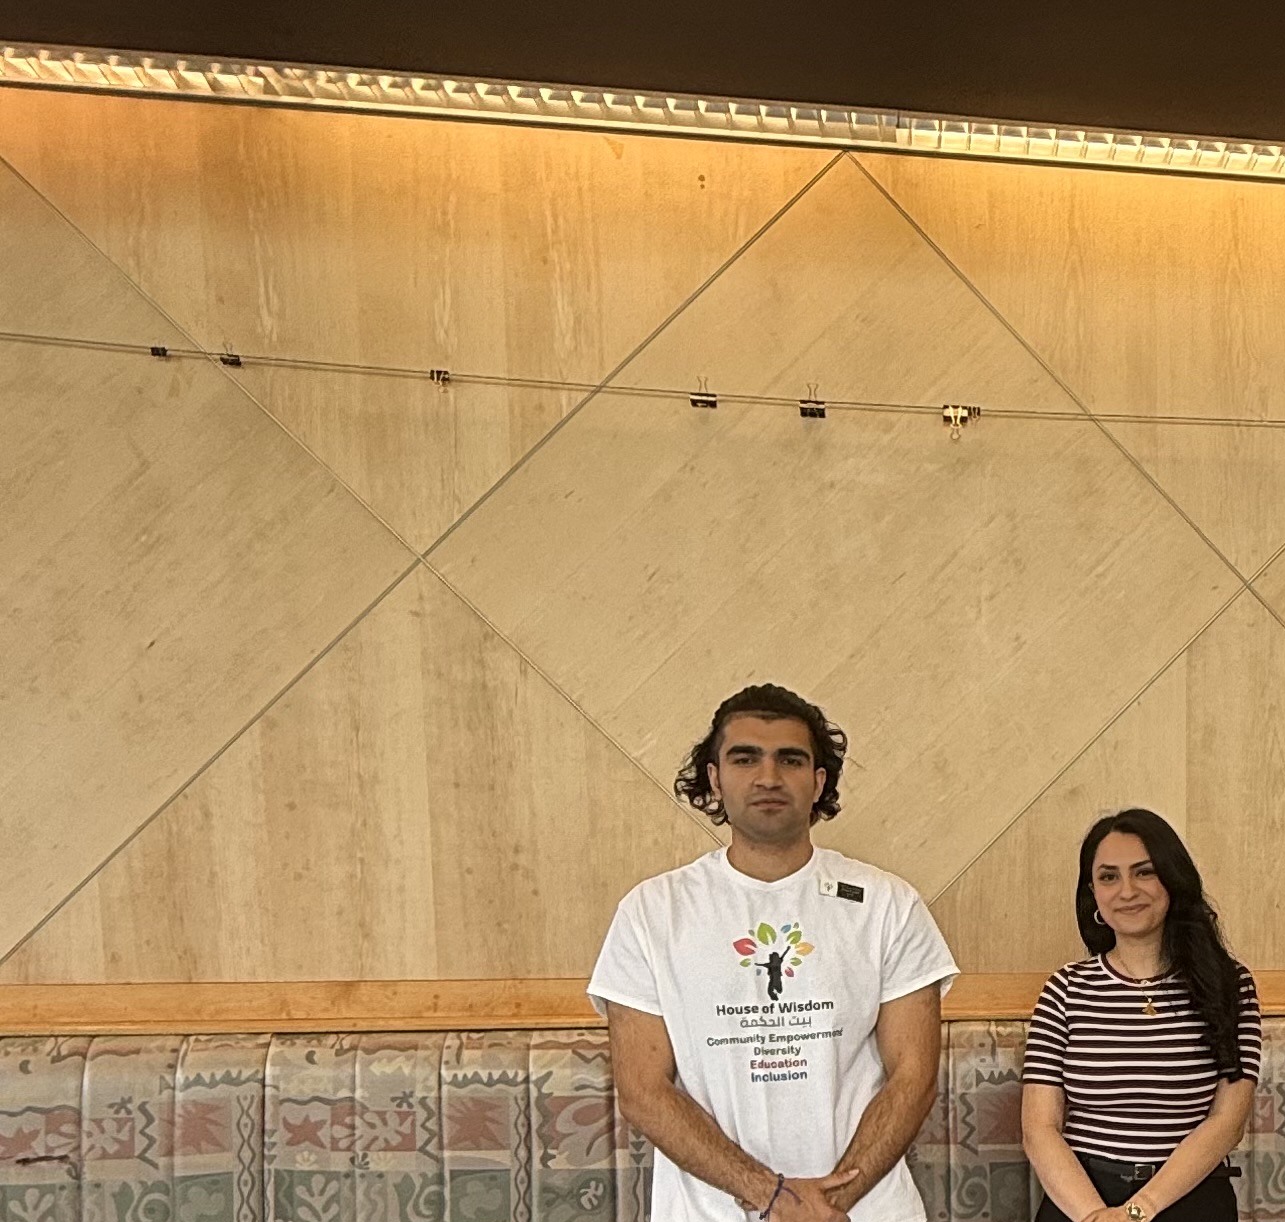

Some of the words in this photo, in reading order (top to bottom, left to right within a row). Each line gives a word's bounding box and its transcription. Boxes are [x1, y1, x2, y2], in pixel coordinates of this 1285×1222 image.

[717, 1005, 758, 1016] House
[762, 1003, 774, 1014] of
[779, 1000, 833, 1013] Wisdom
[707, 1034, 765, 1046] Community
[754, 1046, 801, 1056] Diversity
[750, 1059, 807, 1069] Education
[751, 1071, 807, 1082] Inclusion
